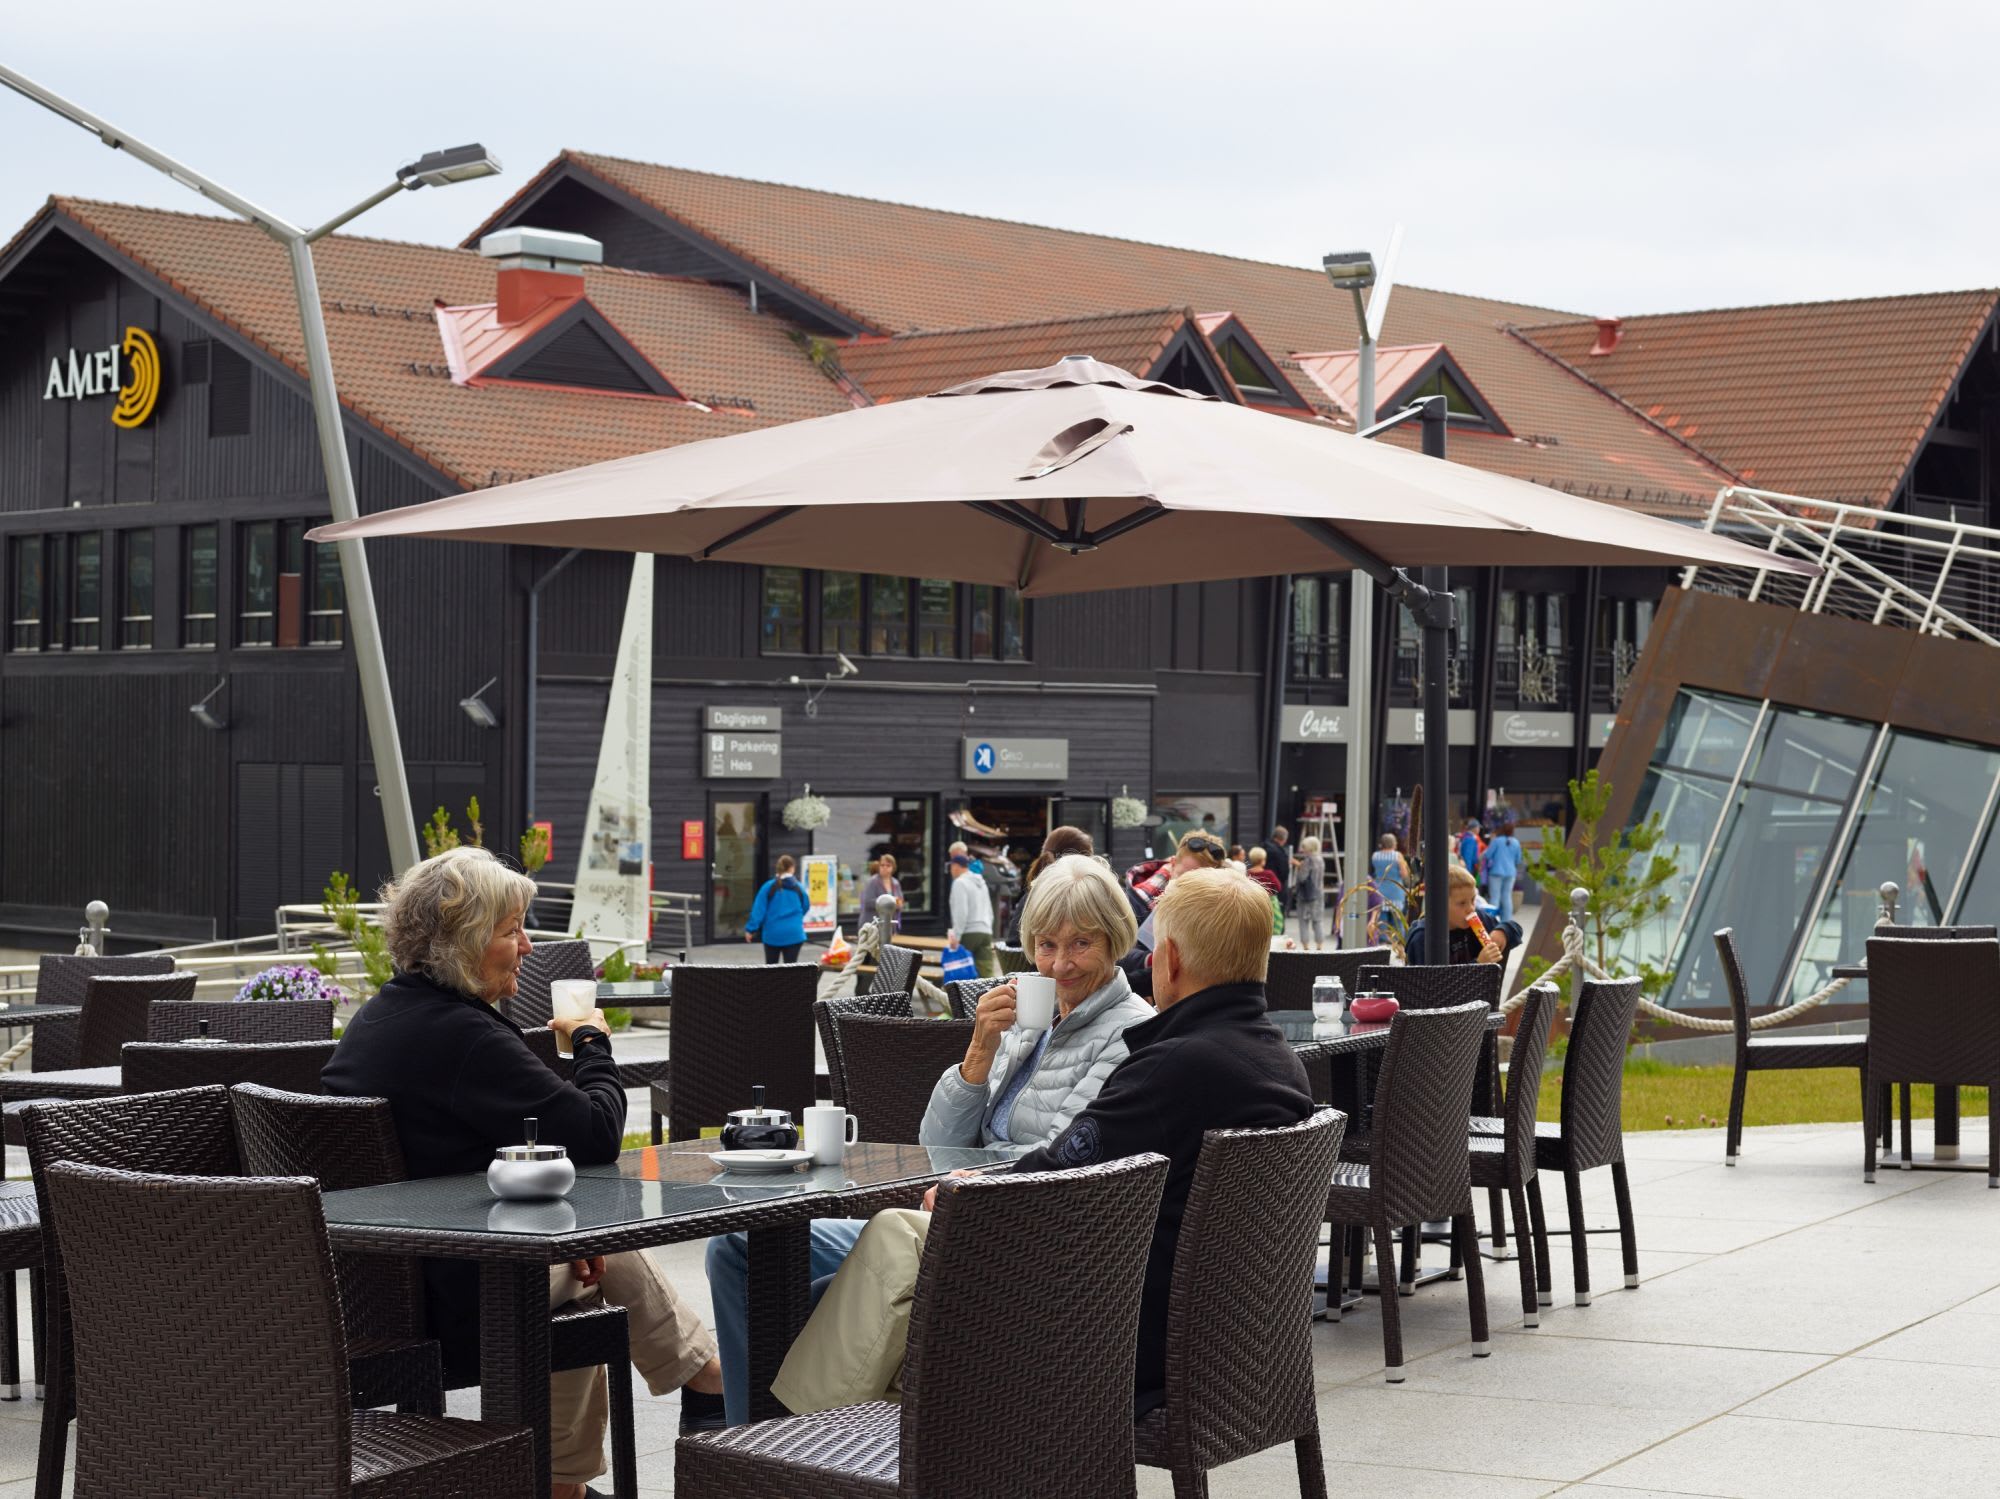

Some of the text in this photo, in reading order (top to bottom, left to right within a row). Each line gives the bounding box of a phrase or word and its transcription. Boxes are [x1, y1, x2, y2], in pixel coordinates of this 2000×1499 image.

[43, 344, 121, 400] AMFI
[714, 711, 767, 727] Dagligvare
[1299, 709, 1341, 738] Capri
[730, 740, 778, 755] Parkering
[730, 759, 753, 771] Heis
